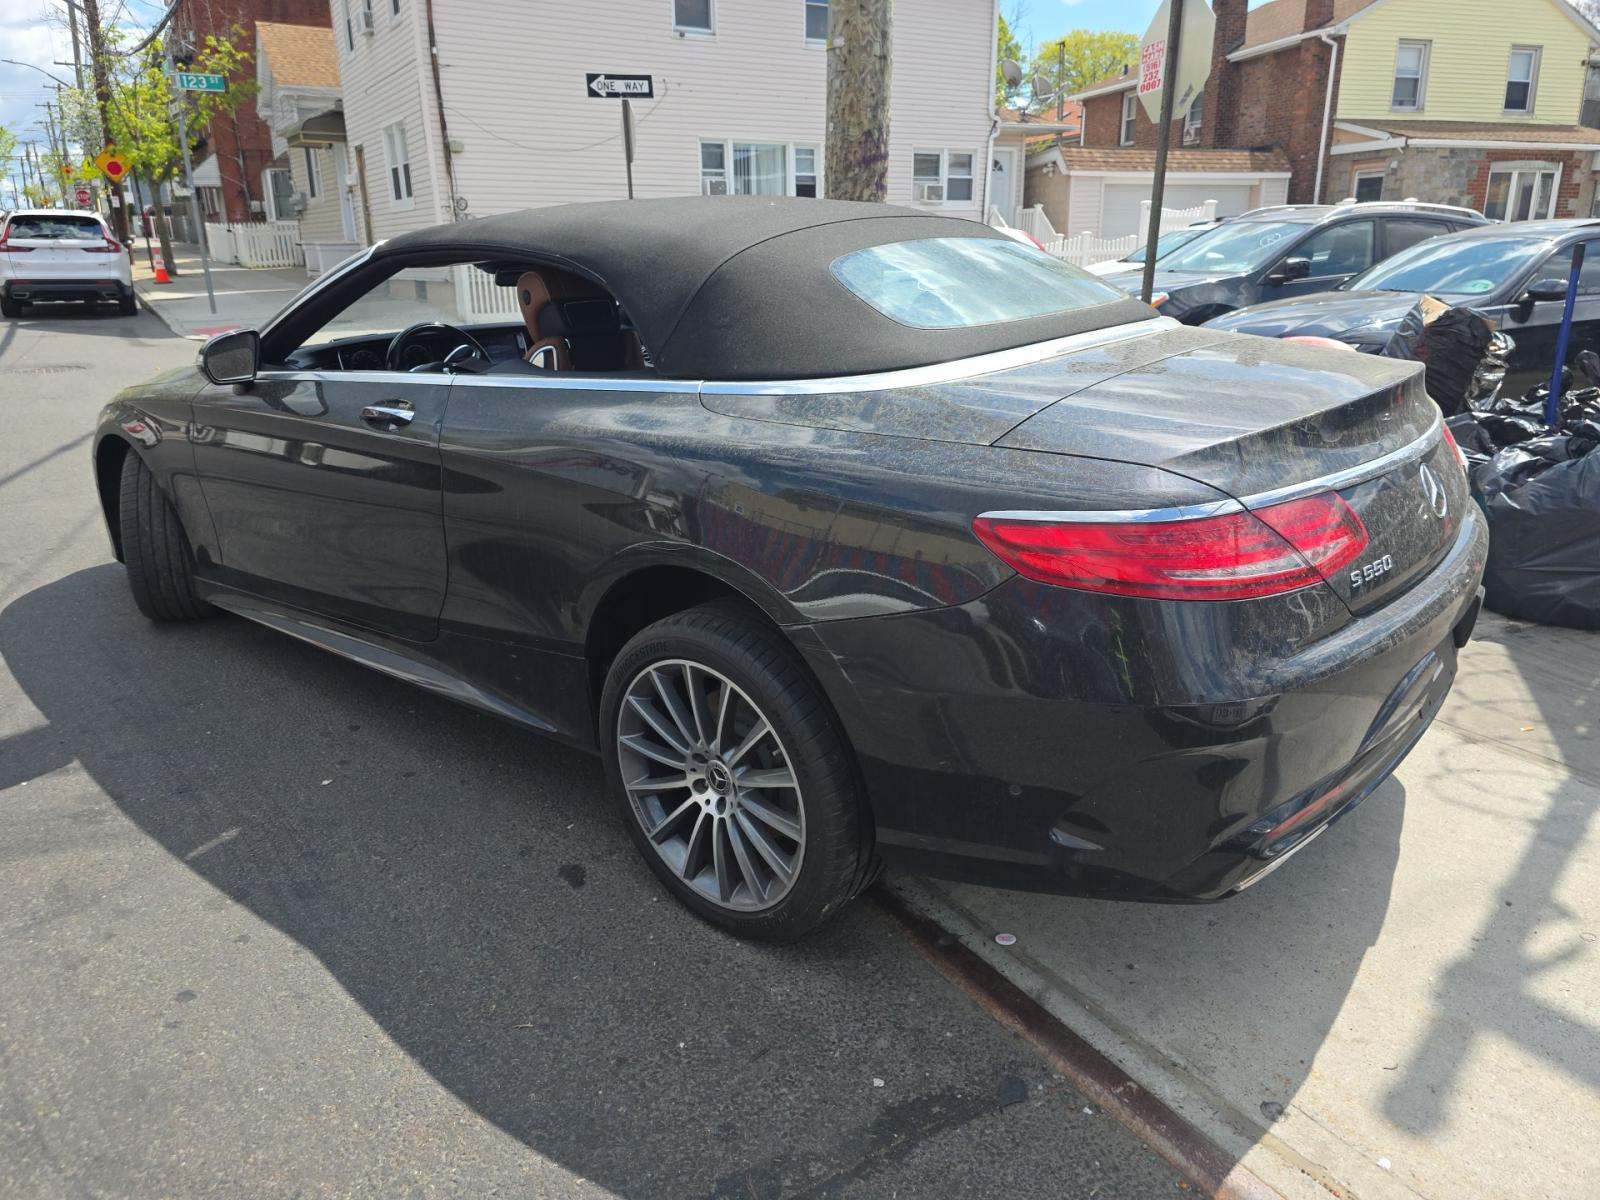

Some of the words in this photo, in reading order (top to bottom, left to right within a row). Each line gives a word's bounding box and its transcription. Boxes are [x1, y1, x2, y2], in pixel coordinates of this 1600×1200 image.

[182, 75, 207, 88] 123
[596, 81, 615, 91] ONE
[624, 81, 644, 91] WAY
[1350, 570, 1363, 588] S
[1363, 554, 1393, 581] 550
